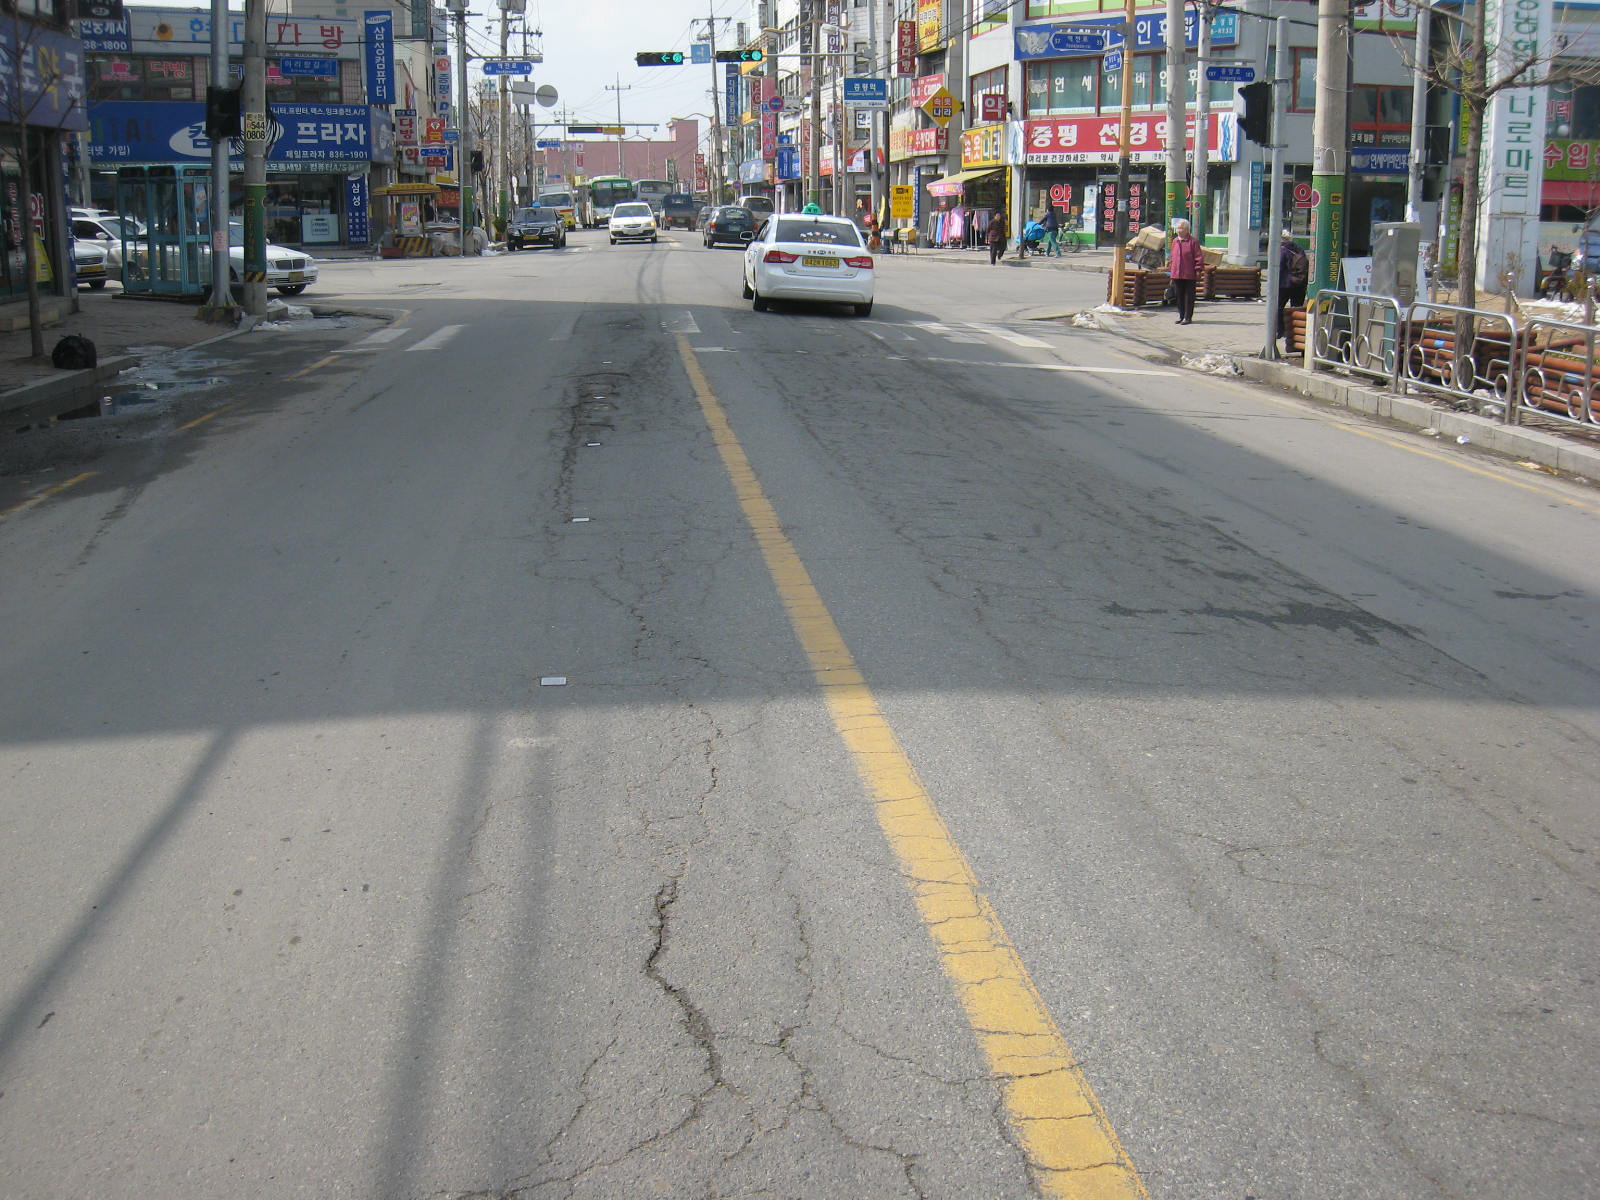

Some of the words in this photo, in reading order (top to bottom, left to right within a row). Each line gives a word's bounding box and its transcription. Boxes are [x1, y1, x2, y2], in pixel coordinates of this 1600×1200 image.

[373, 26, 387, 99] 삼성컴퓨터
[297, 123, 366, 145] 프라자
[1032, 124, 1078, 147] 증평
[1028, 155, 1048, 163] 여러분
[352, 183, 361, 206] 삼성
[1050, 184, 1072, 213] 약
